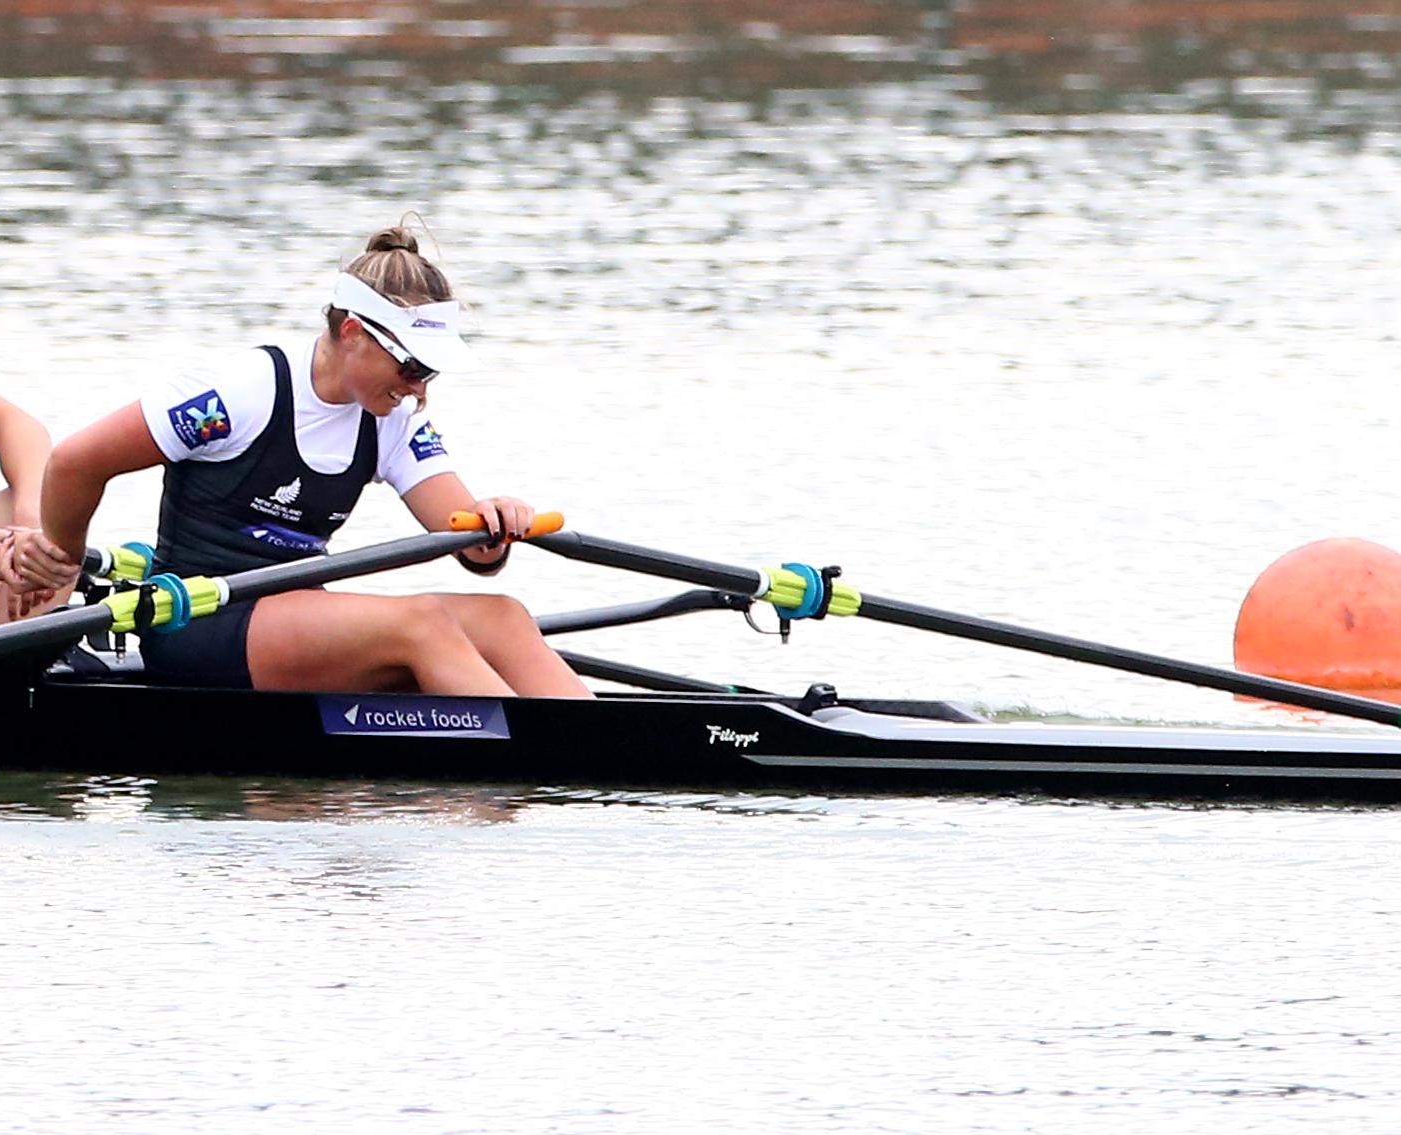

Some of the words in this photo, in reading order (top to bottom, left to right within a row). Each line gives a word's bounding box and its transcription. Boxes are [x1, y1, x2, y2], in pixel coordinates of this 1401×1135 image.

[365, 709, 426, 727] rocket
[431, 708, 482, 729] foods
[706, 724, 759, 748] Filippi
